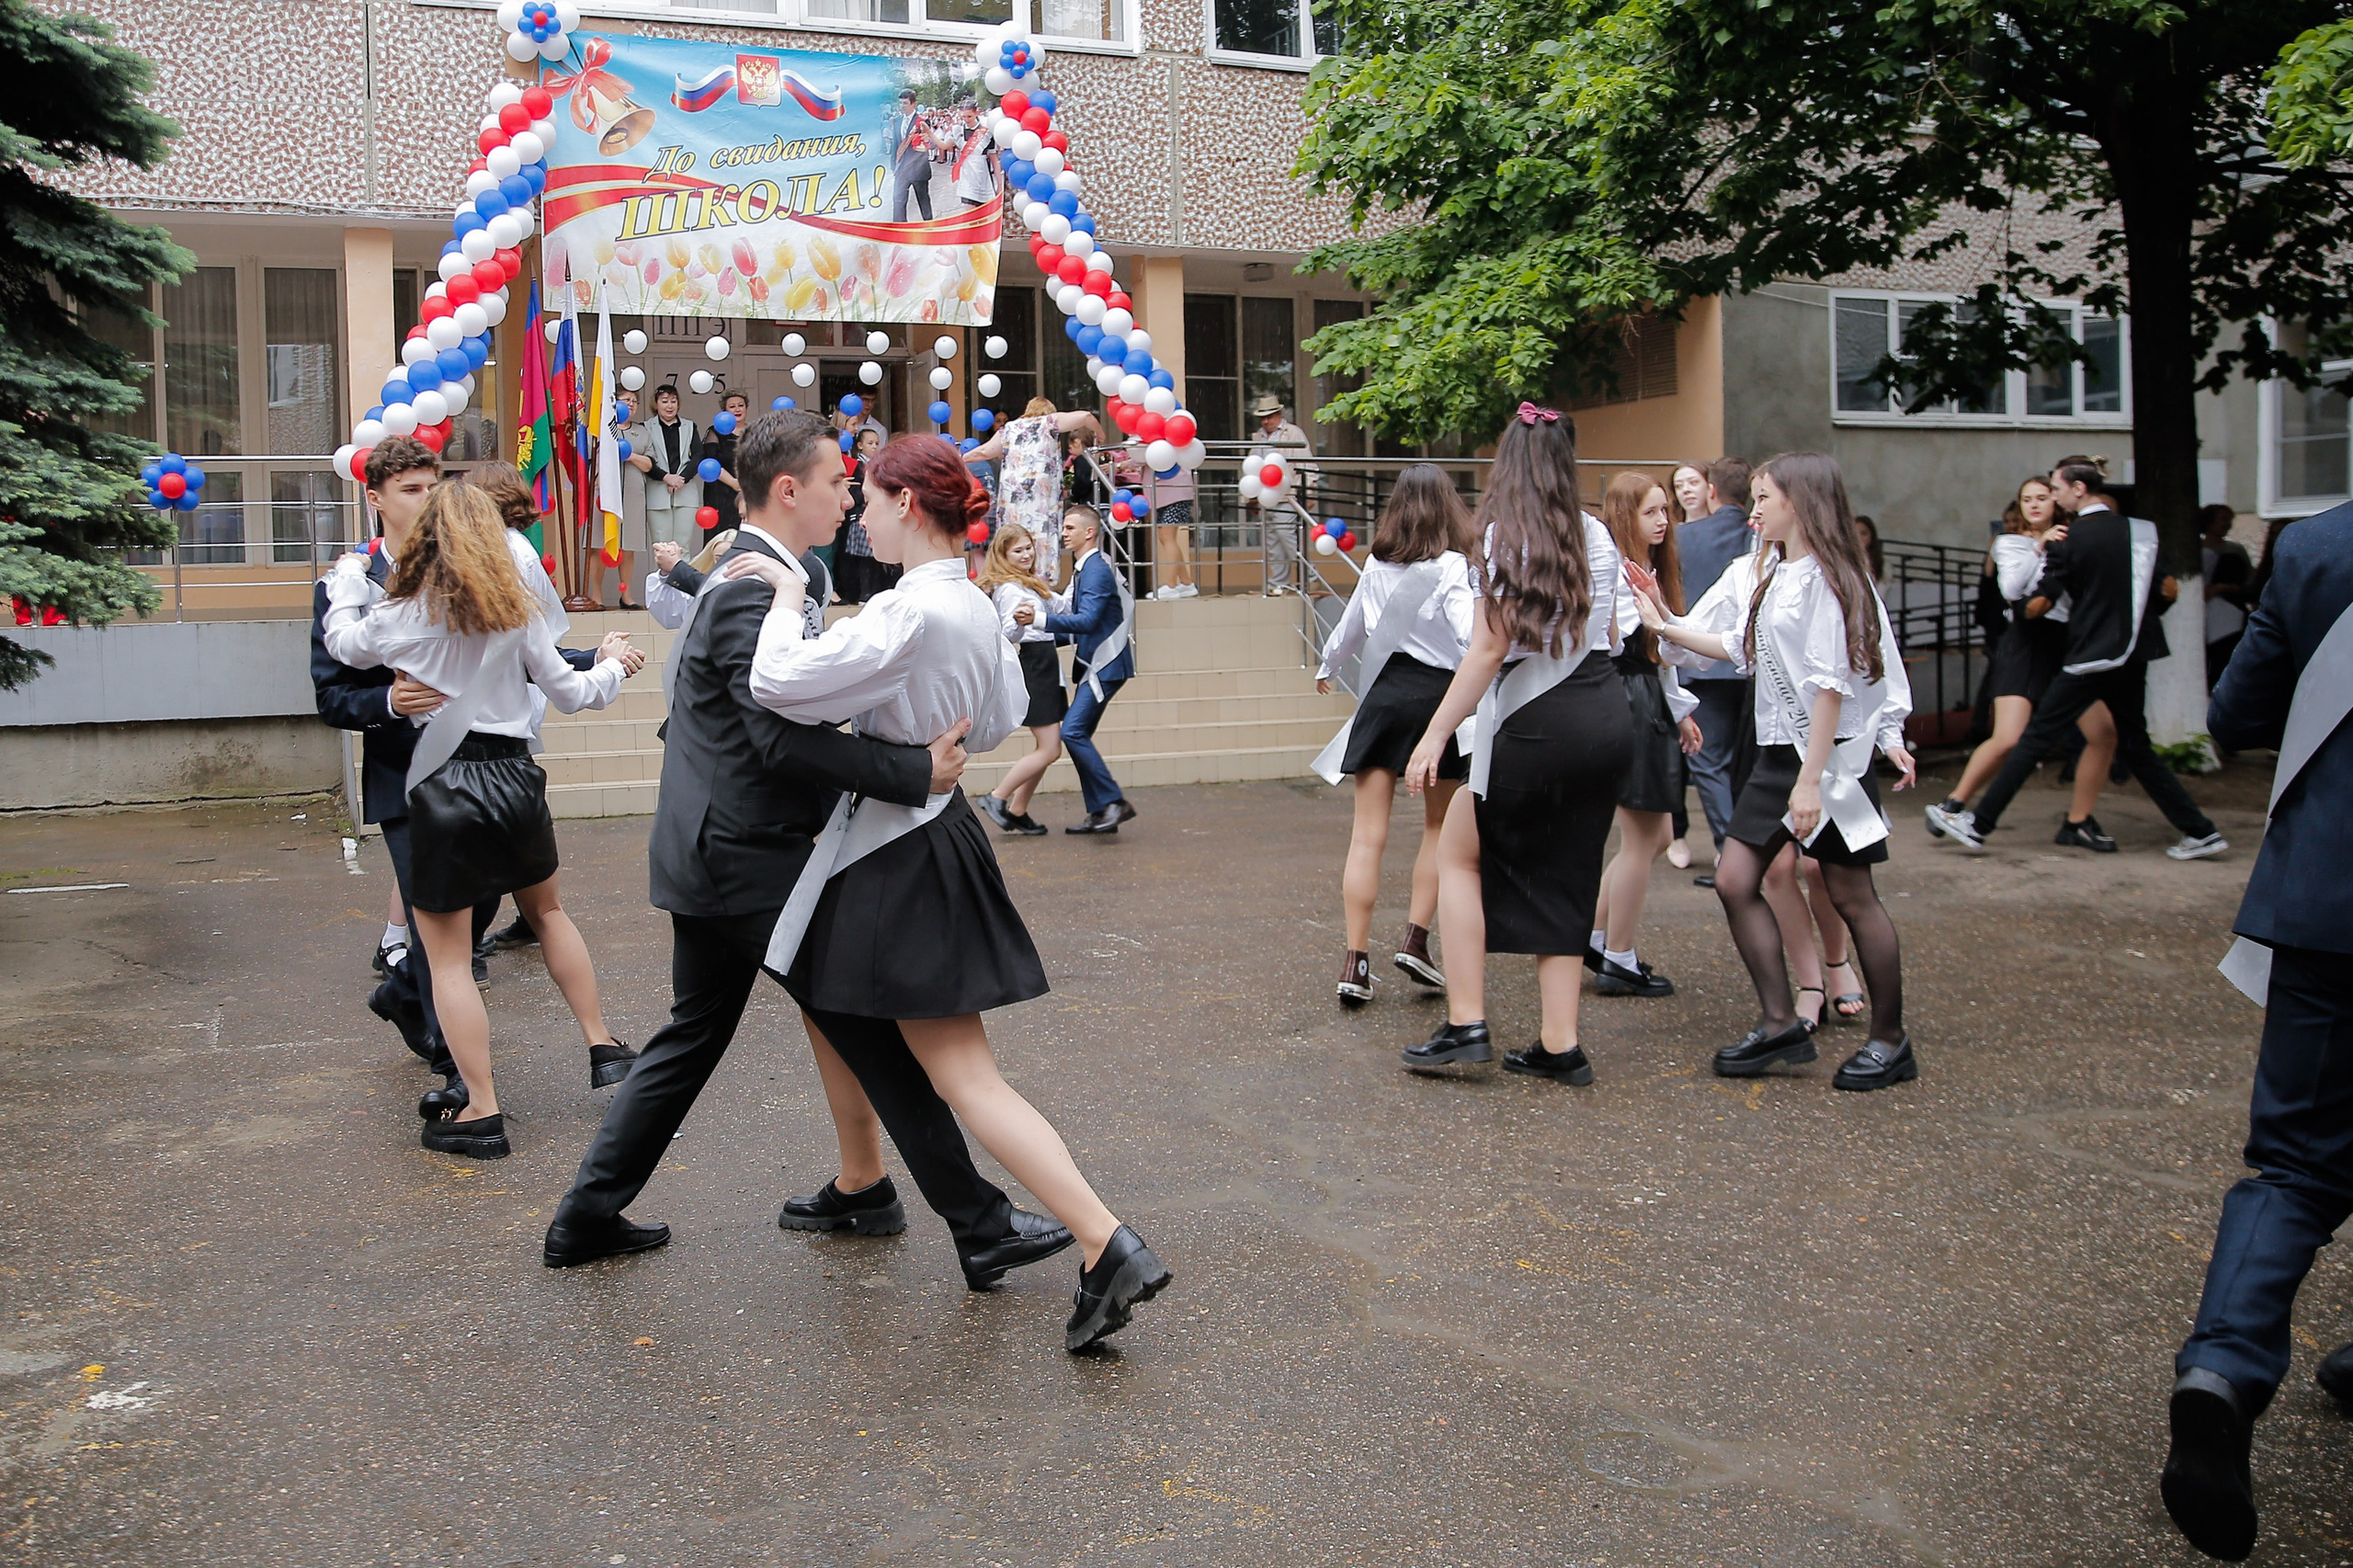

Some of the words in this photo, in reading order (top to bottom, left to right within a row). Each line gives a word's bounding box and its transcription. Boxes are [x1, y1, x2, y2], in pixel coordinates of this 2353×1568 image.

[642, 144, 696, 183] До
[709, 133, 867, 169] свидания,
[615, 165, 886, 242] ШКОЛА!
[665, 373, 726, 394] 75
[1788, 708, 1811, 747] 202
